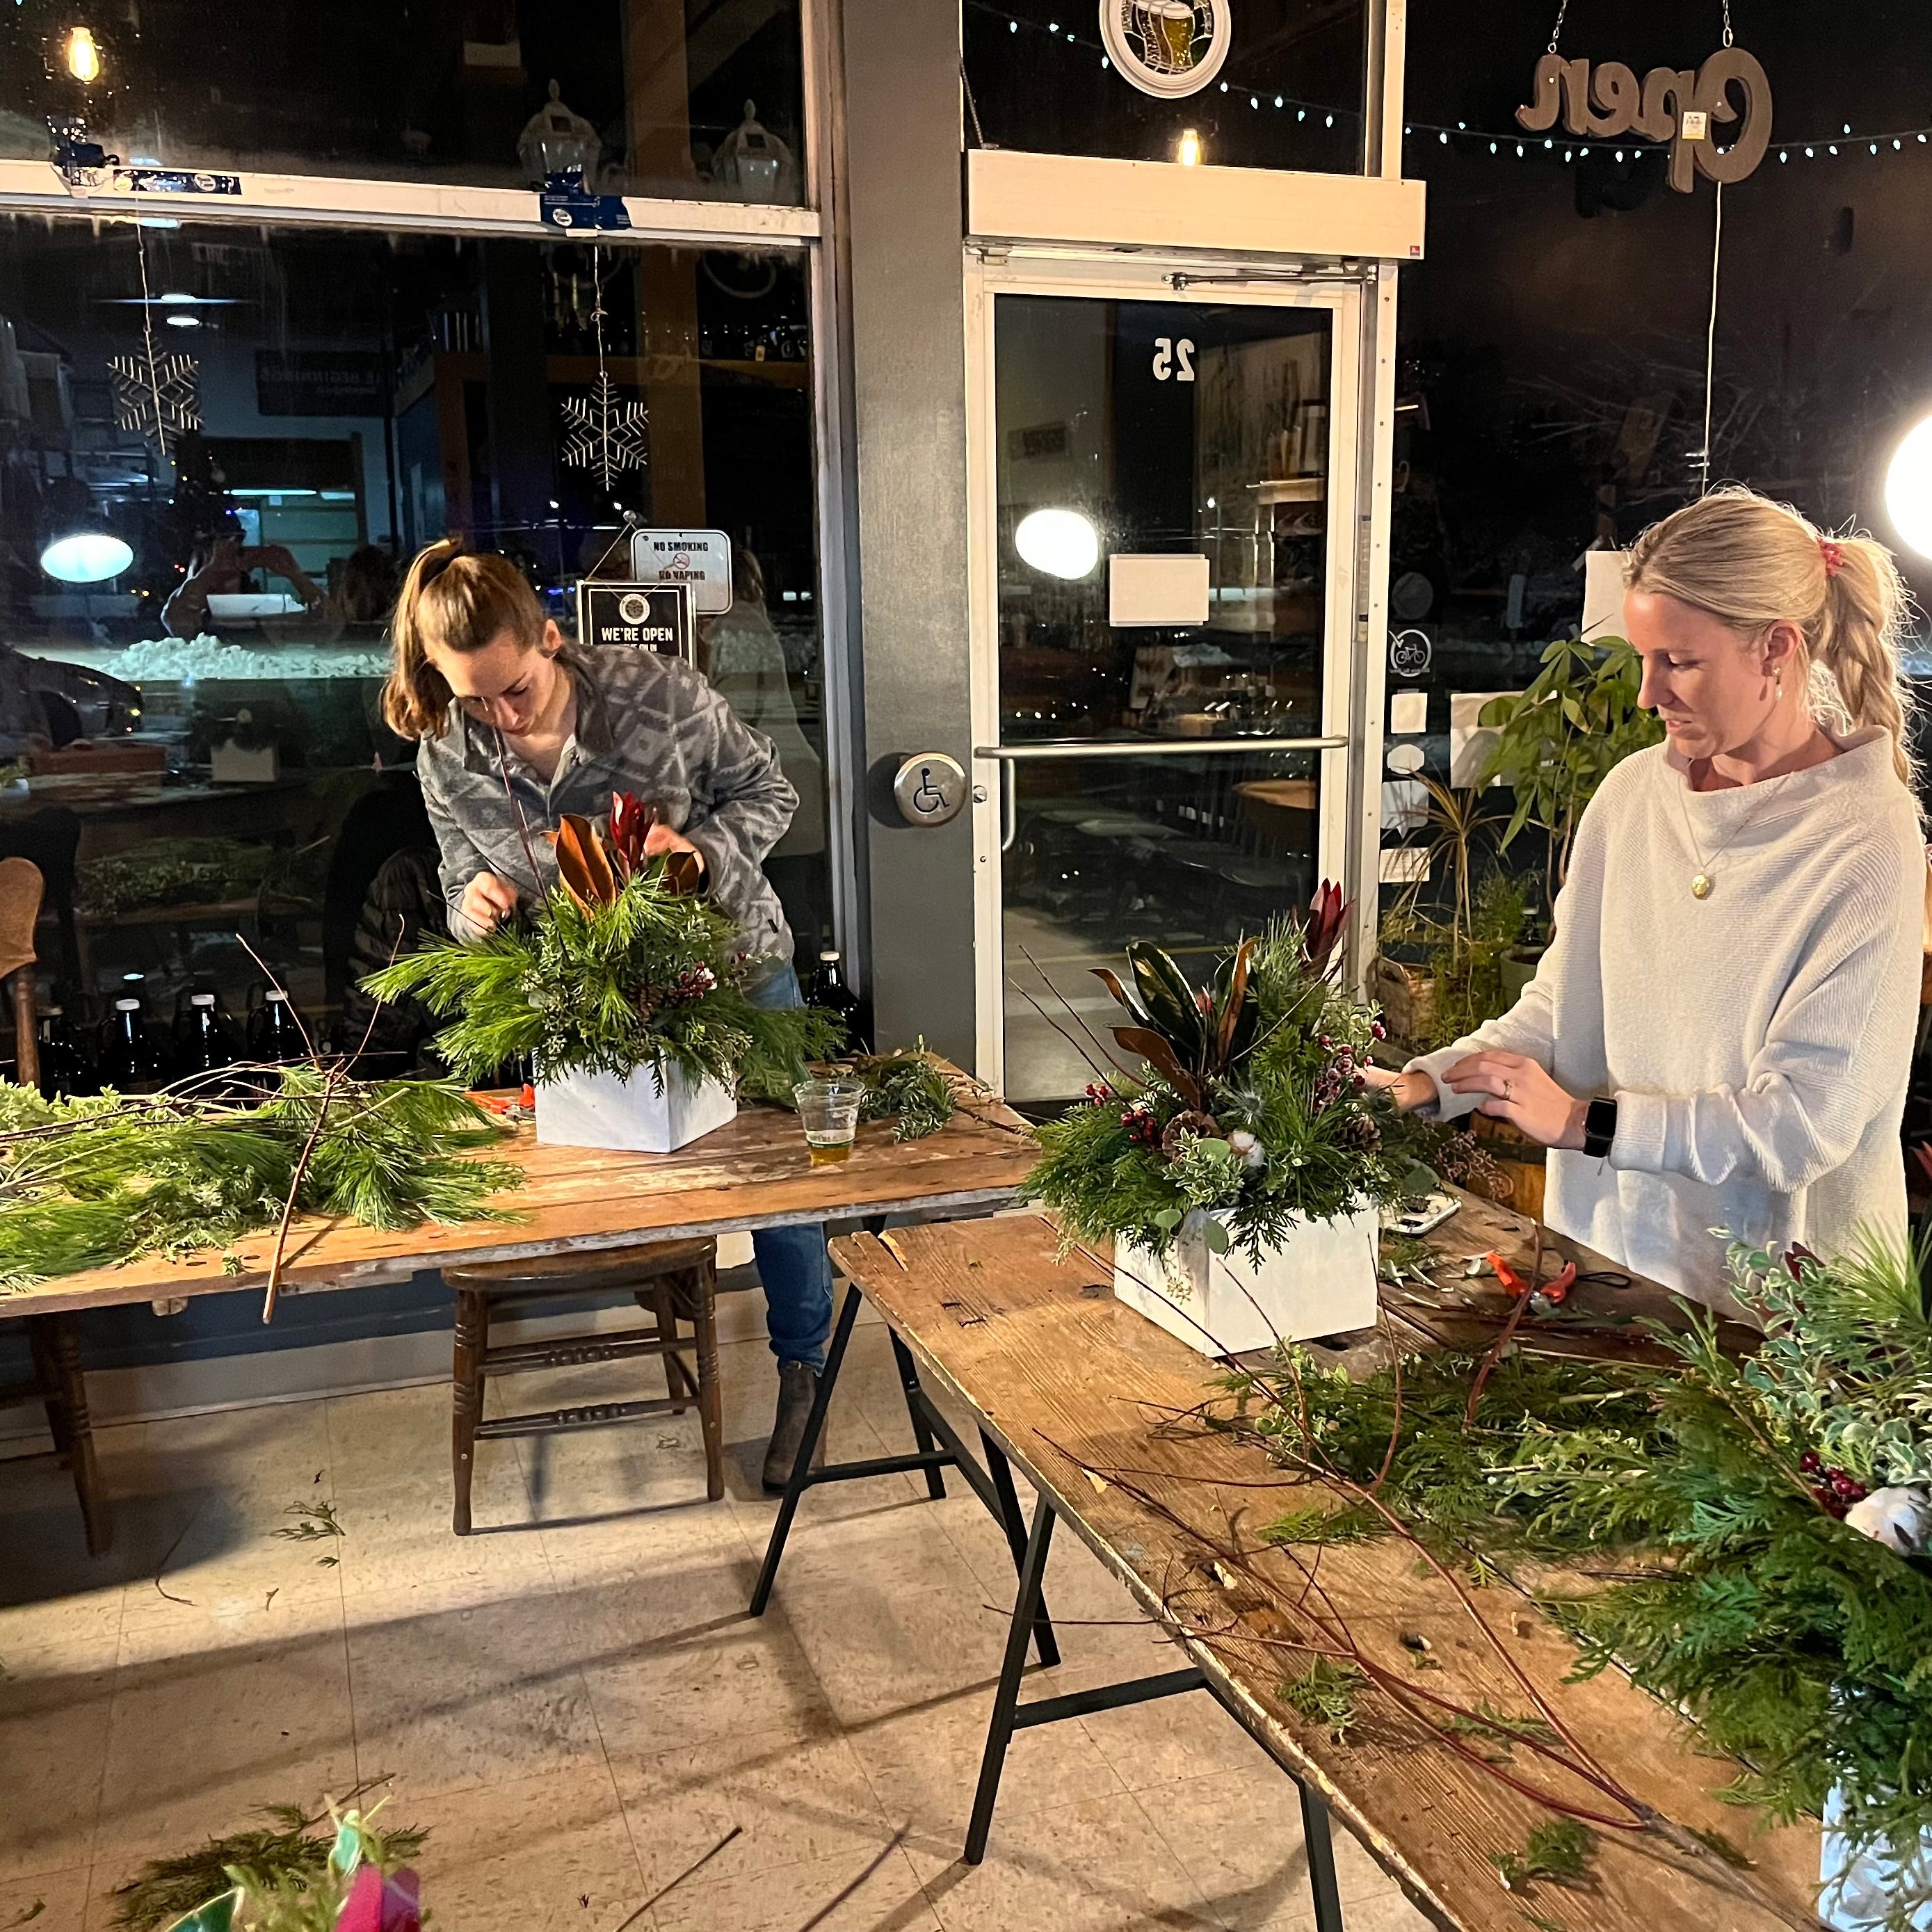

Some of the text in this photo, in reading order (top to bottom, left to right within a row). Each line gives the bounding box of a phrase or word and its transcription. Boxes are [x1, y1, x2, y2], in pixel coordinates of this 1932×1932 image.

[653, 542, 709, 552] NO SMOKING
[659, 570, 705, 581] NO VAPING
[602, 627, 673, 641] WE'RE OPEN
